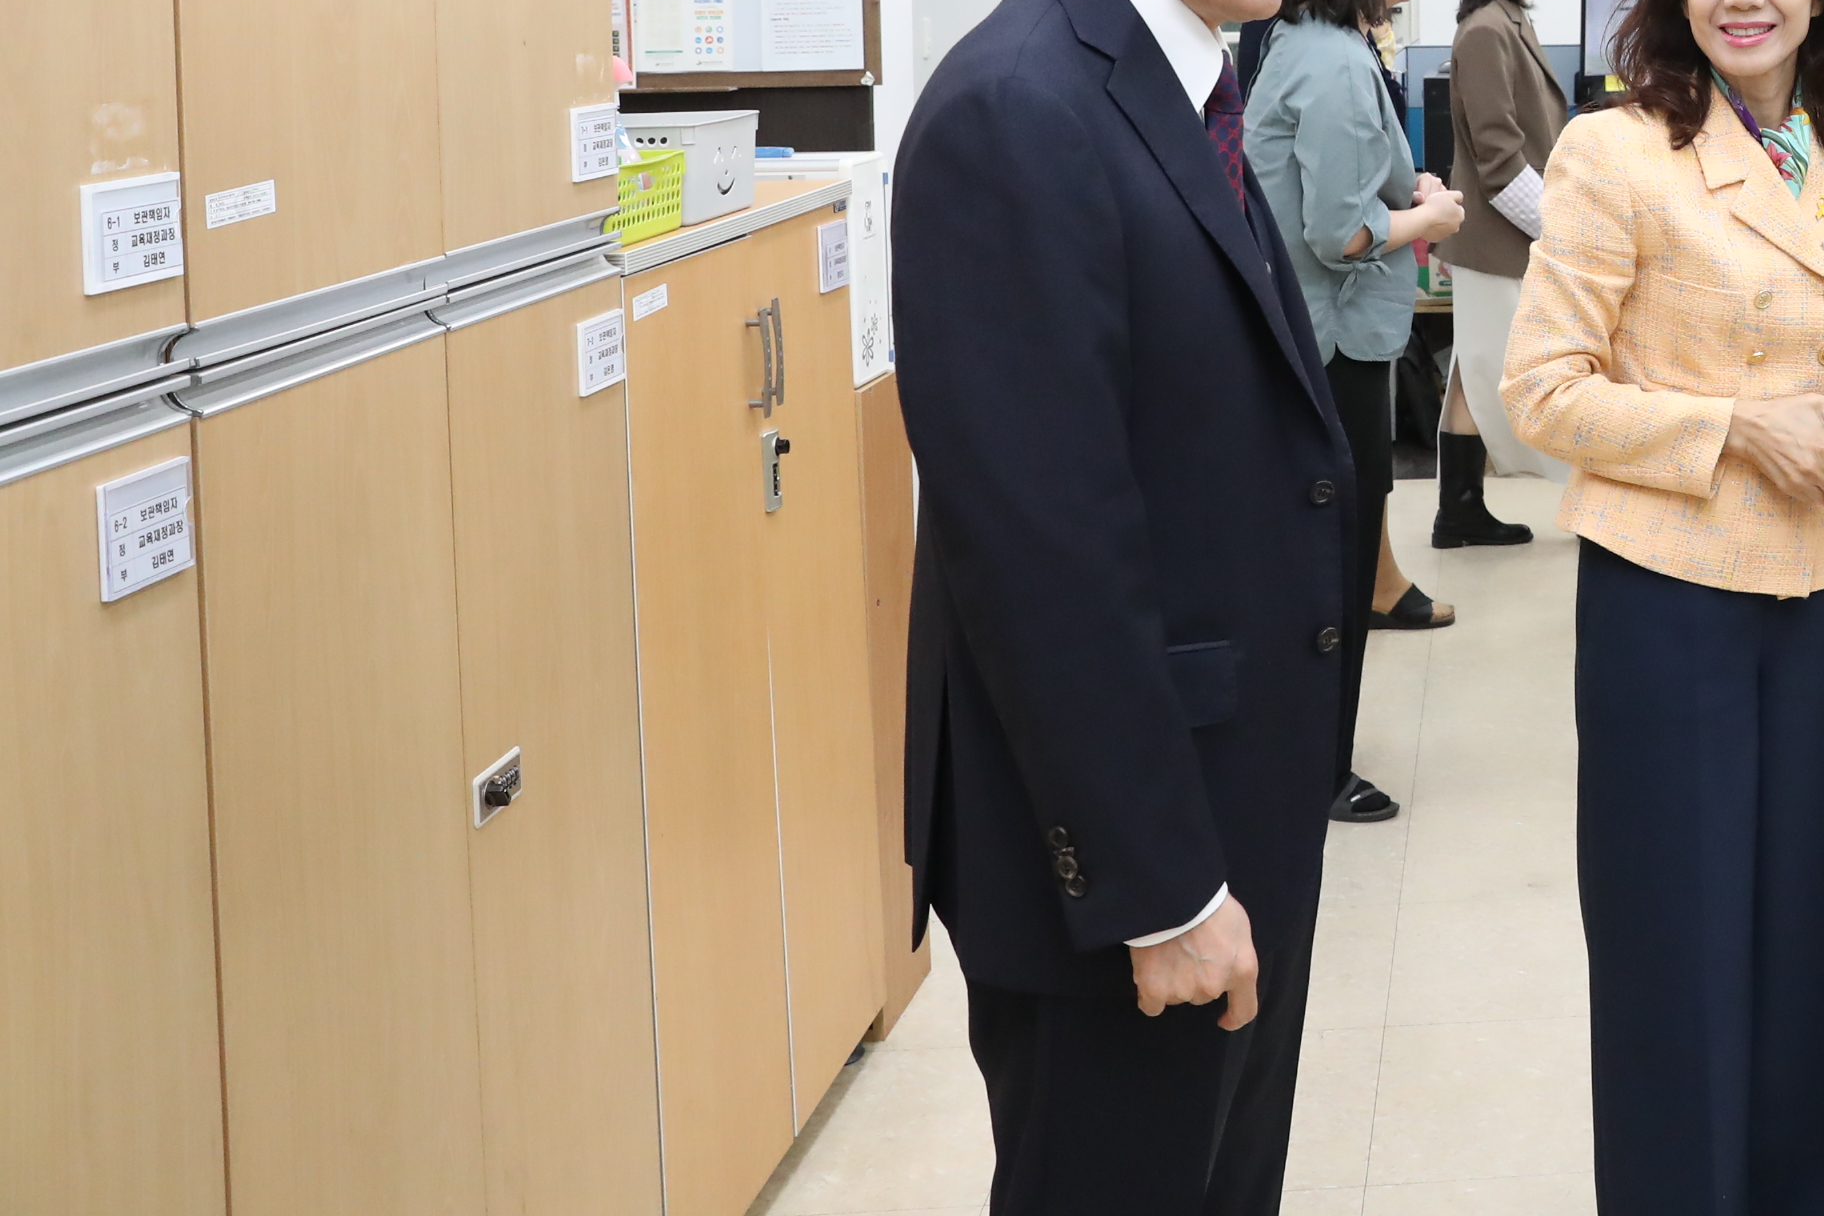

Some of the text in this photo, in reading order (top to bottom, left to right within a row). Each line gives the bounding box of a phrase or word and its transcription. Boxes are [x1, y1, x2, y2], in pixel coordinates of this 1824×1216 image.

[107, 216, 120, 229] 6-1
[134, 206, 170, 224] 보관책임자
[112, 227, 175, 252] 정 교육재정과장
[113, 251, 166, 274] 부 김태연
